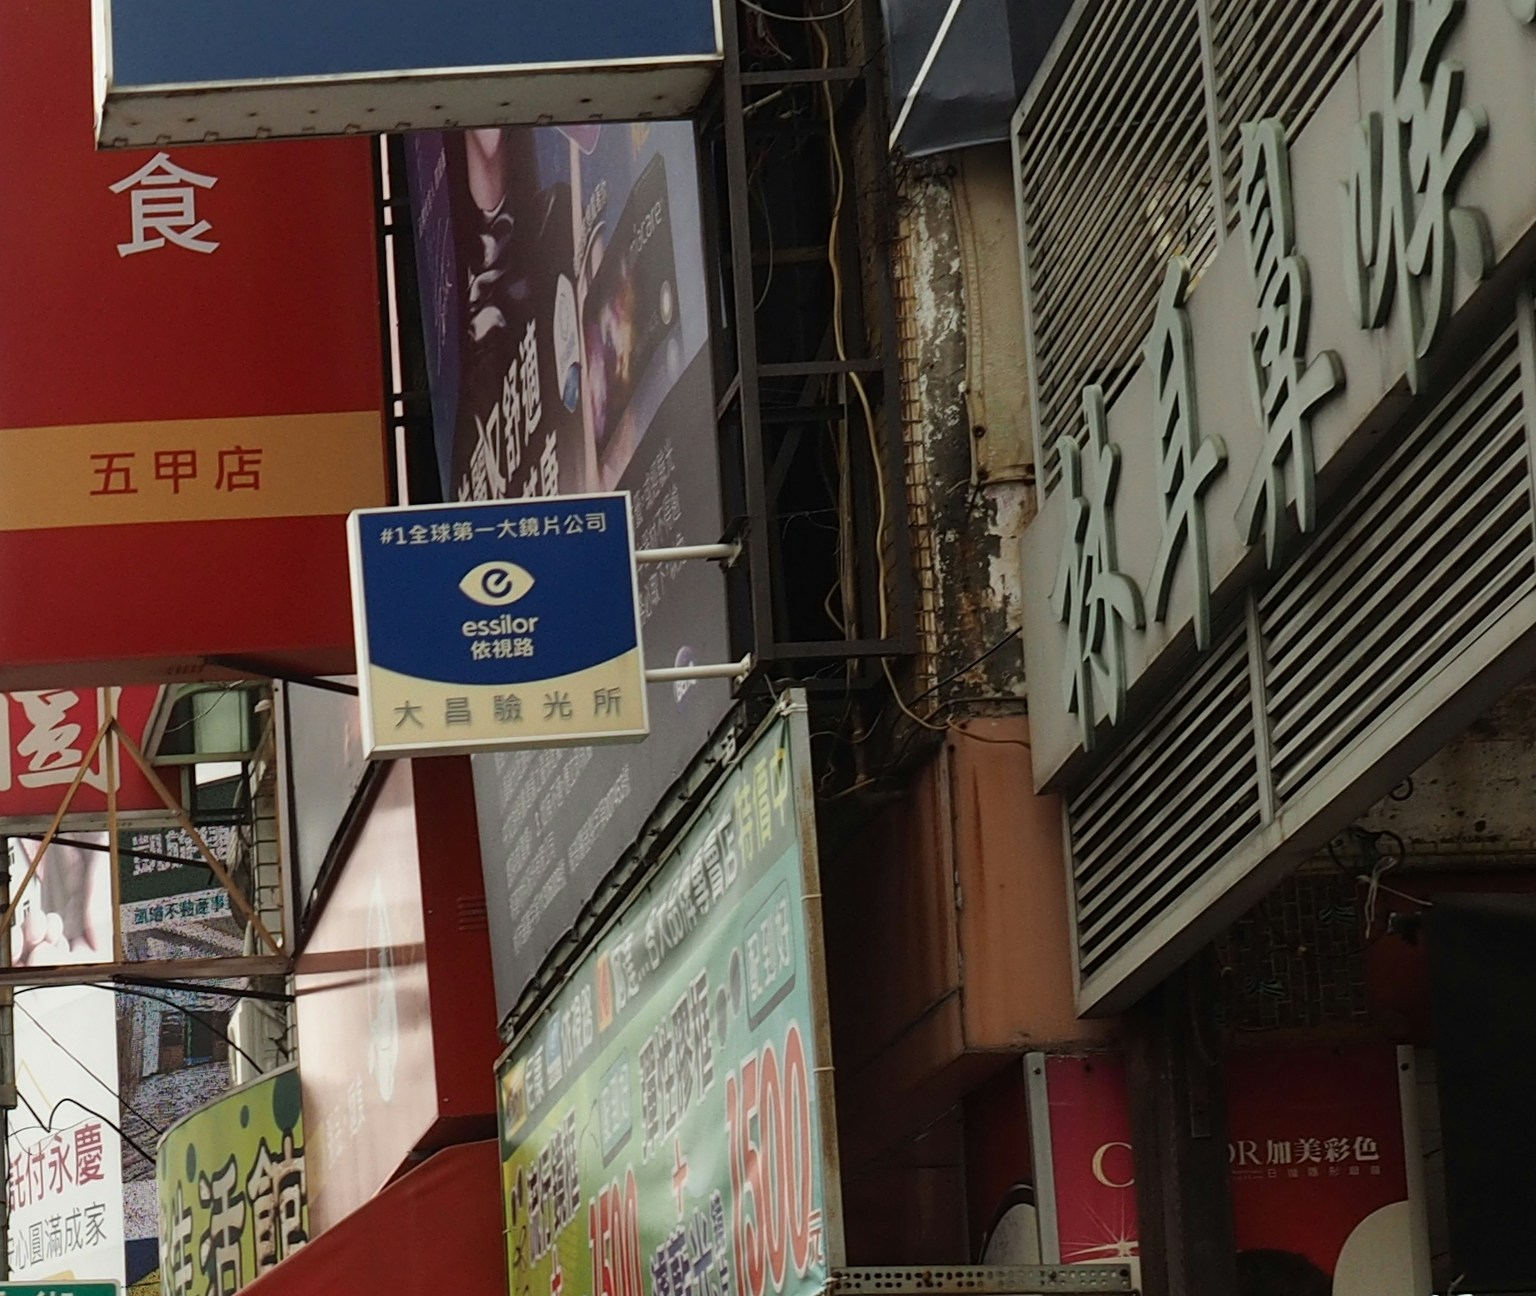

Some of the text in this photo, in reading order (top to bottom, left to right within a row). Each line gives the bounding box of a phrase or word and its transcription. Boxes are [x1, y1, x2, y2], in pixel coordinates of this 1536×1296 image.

[88, 446, 264, 499] 五甲店
[461, 612, 539, 639] essilor
[470, 638, 534, 661] 依視路
[394, 685, 624, 731] 大昌驗光所
[1265, 1135, 1381, 1167] 加美彩色
[6, 1201, 109, 1274] 心圓滿成家
